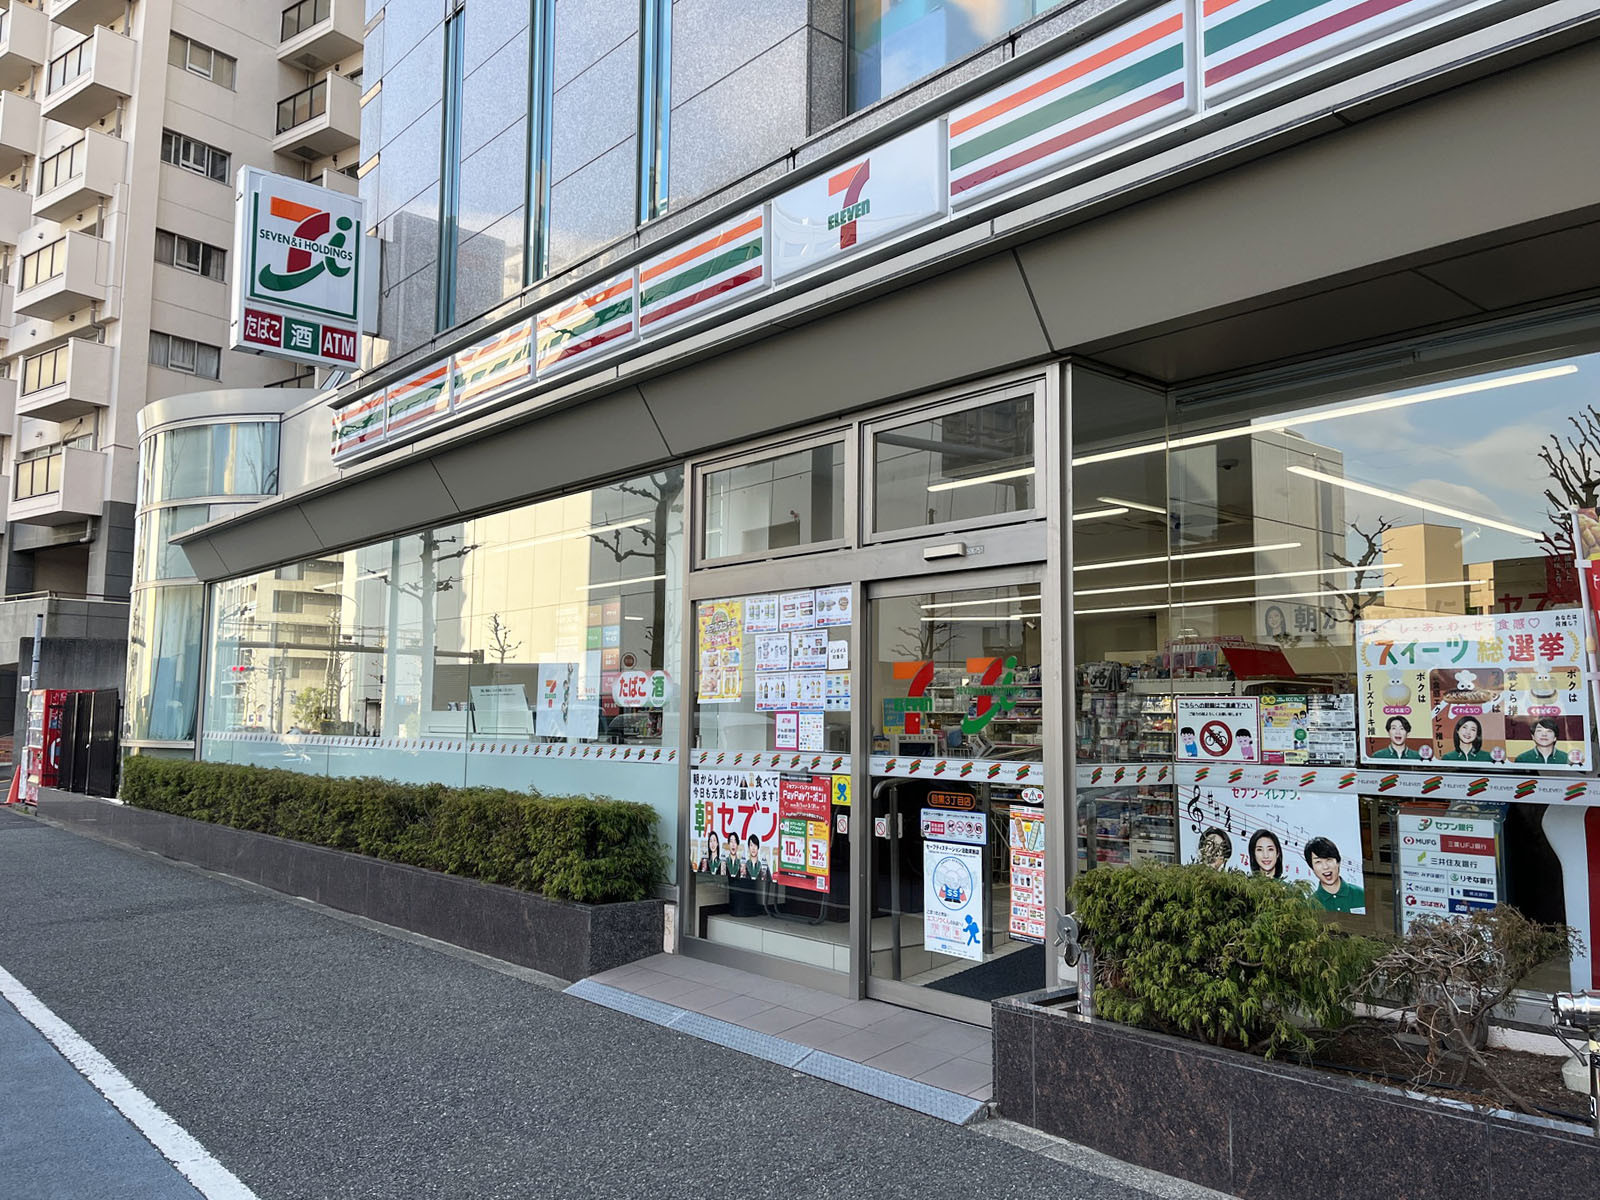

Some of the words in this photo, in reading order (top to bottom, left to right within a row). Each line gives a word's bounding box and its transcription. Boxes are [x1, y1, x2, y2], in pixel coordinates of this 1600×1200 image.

[304, 240, 353, 261] HOLDINGS
[245, 314, 280, 342] たばこ
[291, 323, 314, 348] 酒
[323, 331, 354, 358] ATM
[619, 676, 647, 698] たばこ
[652, 676, 665, 698] 酒
[1416, 672, 1426, 703] ボクは
[1567, 669, 1577, 703] ボクは
[693, 773, 739, 787] 朝からしっかり
[755, 775, 779, 788] 食べて
[694, 800, 777, 842] 朝セブン
[1435, 820, 1474, 832] セブン銀行
[785, 841, 801, 857] 10%
[811, 844, 825, 861] 3%
[1430, 857, 1478, 869] 三井住友銀行
[1460, 875, 1494, 885] りそな銀行
[946, 889, 959, 897] SS
